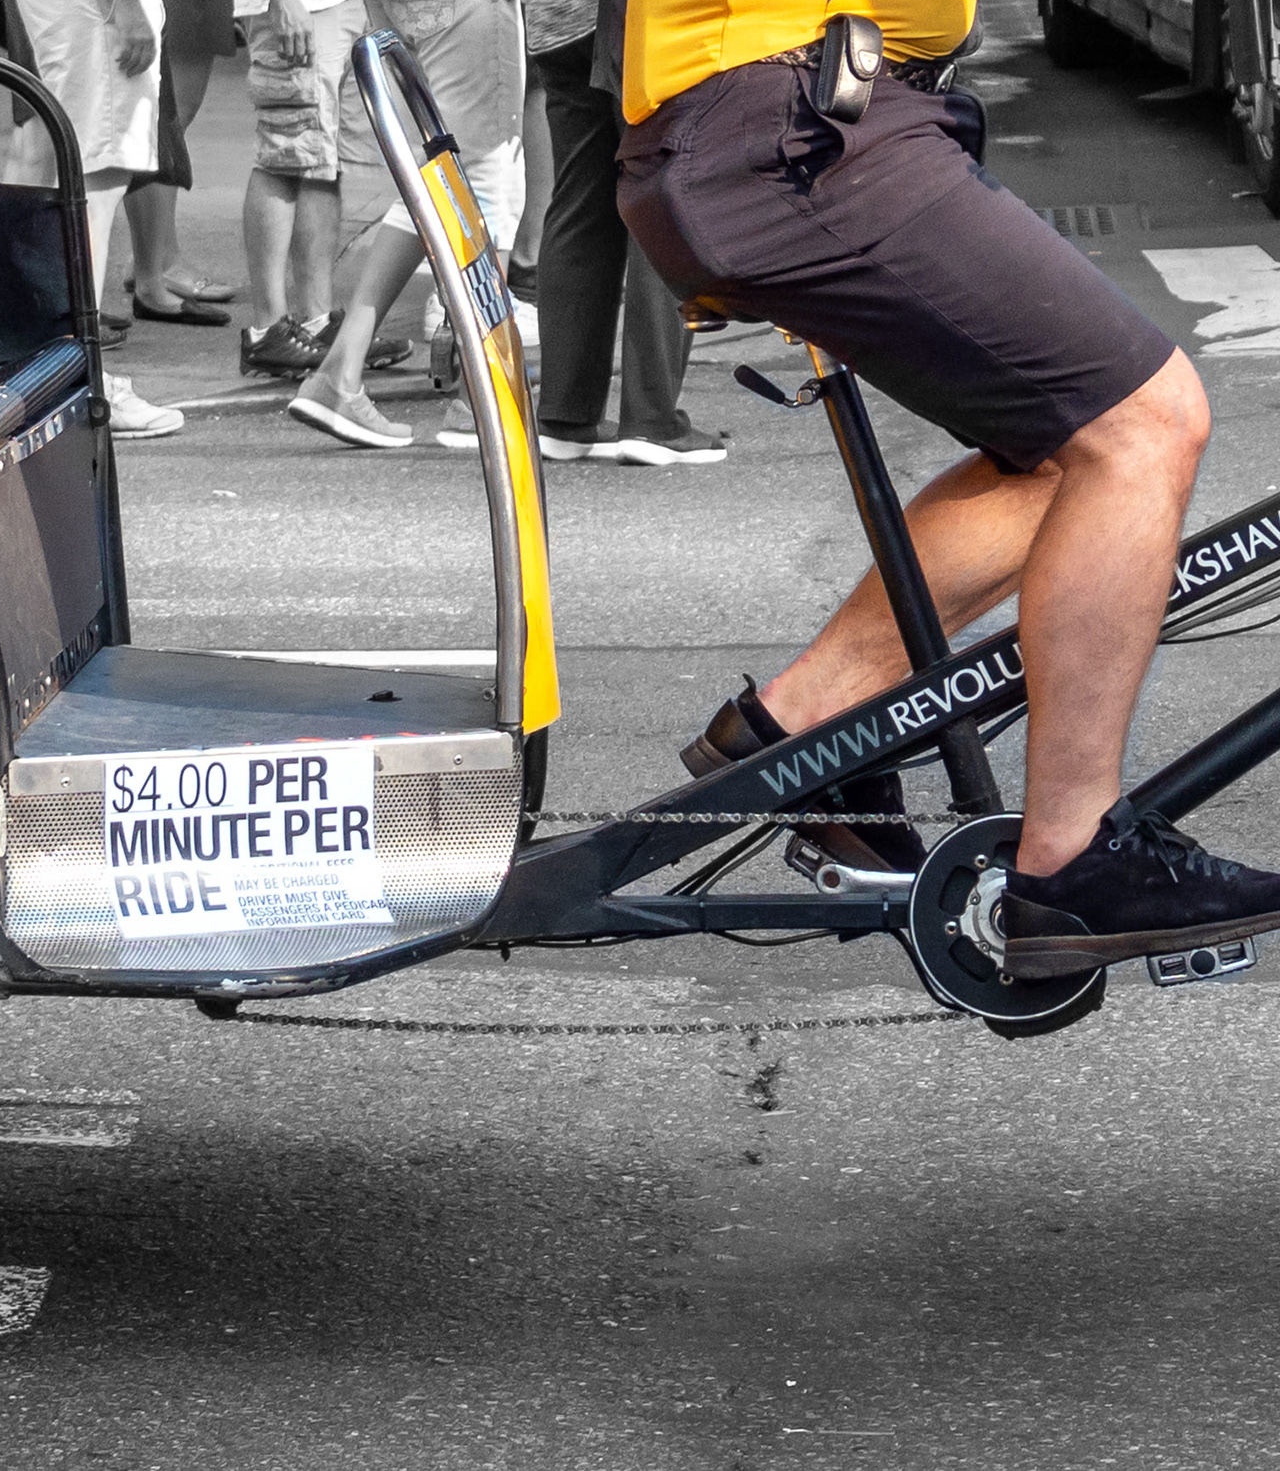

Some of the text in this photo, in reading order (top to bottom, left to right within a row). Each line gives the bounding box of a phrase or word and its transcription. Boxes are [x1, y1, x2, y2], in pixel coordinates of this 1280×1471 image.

[112, 755, 328, 814] $4.00 PER
[110, 805, 371, 867] MINUTE PER
[114, 870, 228, 917] RIDE
[234, 879, 260, 892] MAY
[264, 877, 279, 890] BE
[238, 889, 350, 907] DRIVER MUST GIVE
[242, 899, 387, 918] PASSENGERS A PEDICAB
[247, 912, 329, 927] INFORMATION
